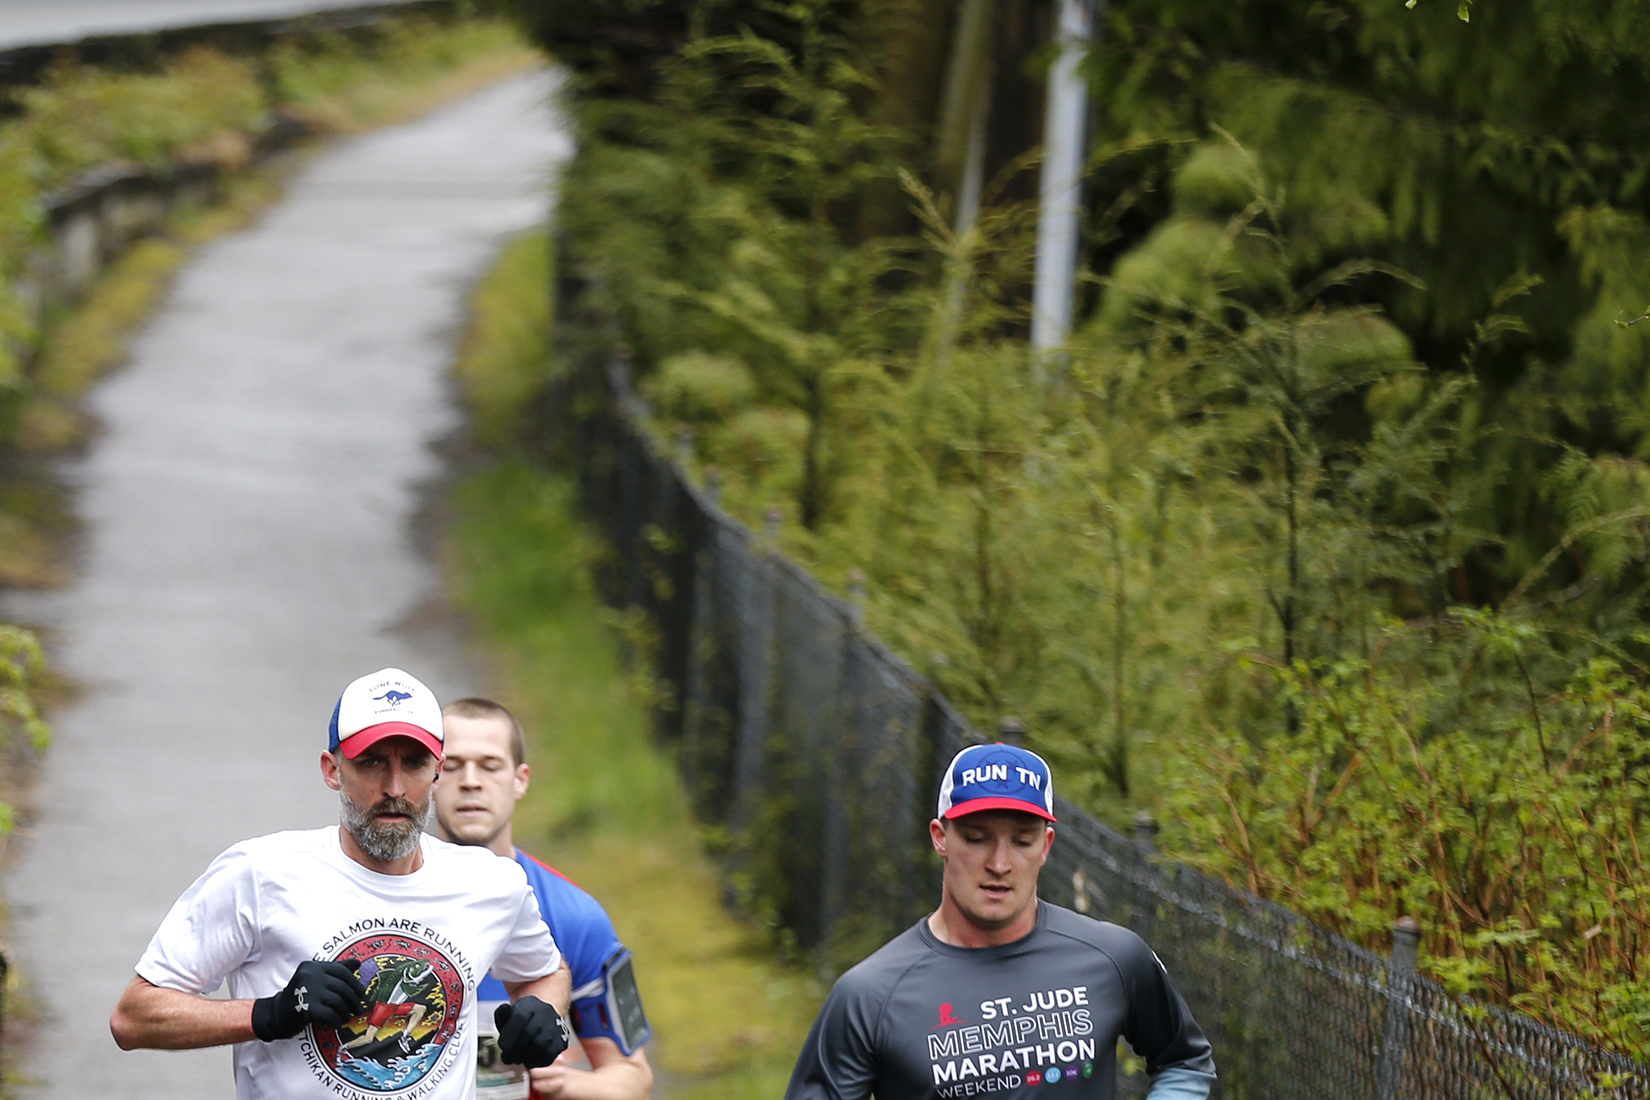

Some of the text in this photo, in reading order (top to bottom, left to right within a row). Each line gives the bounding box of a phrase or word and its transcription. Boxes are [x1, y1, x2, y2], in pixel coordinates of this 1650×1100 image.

[962, 764, 1041, 790] RUN TN
[322, 917, 476, 991] SALMON ARE RUNNING
[980, 986, 1089, 1020] ST. JUDE
[927, 1008, 1093, 1060] MEMPHIS
[298, 1029, 335, 1087] TCHIKAN
[932, 1038, 1096, 1085] MARATHON
[937, 1074, 1022, 1099] WEEKEND
